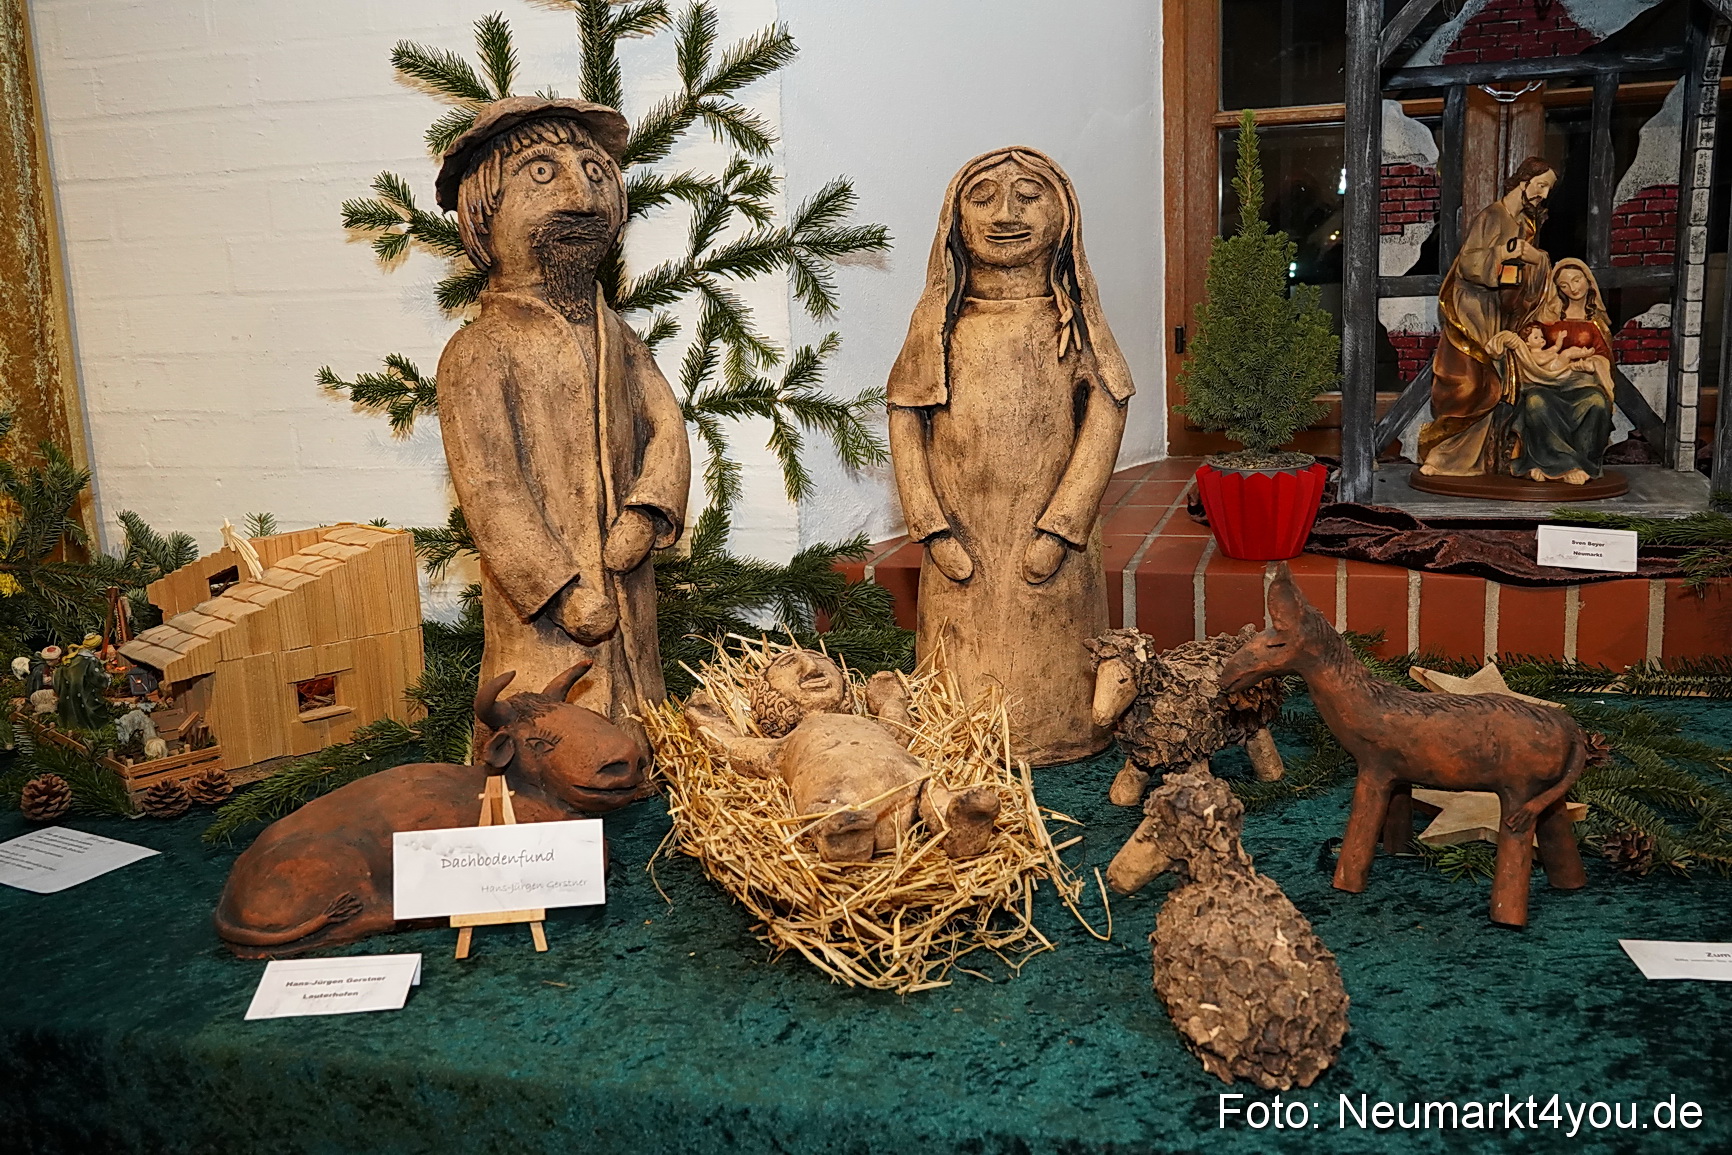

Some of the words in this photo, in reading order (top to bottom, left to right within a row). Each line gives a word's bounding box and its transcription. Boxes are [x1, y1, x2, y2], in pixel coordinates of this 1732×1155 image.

[441, 849, 555, 869] Dachbodenfund
[481, 879, 544, 893] Hans-Jürgen
[546, 879, 588, 888] Gerstner
[285, 977, 344, 987] Hans-Jürgen
[346, 975, 387, 983] Gerstner
[302, 991, 359, 1000] Lauterhofen
